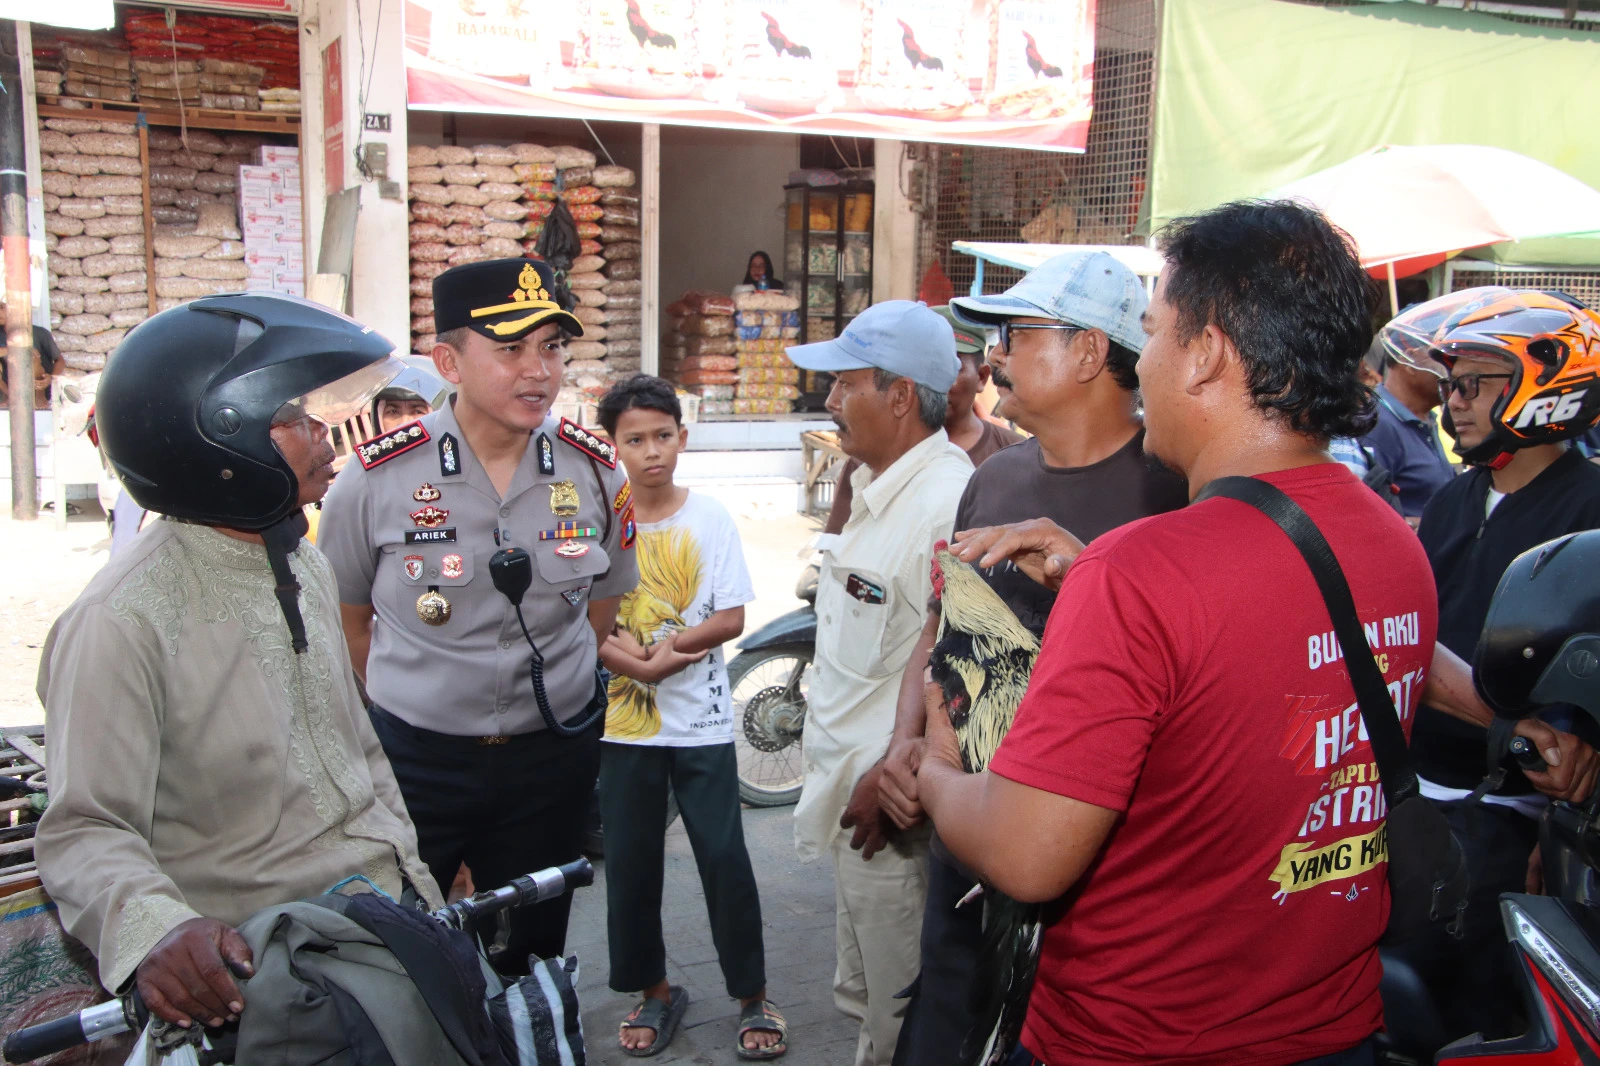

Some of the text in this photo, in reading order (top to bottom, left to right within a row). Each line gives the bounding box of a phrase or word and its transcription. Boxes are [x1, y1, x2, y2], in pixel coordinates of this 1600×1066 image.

[457, 22, 537, 42] RAJAWALI
[366, 115, 388, 129] ZA 1
[1513, 388, 1589, 429] R6
[414, 530, 448, 541] ARIEK
[1307, 611, 1419, 670] BUN AKU
[1329, 763, 1367, 790] TAPI
[1297, 782, 1387, 837] ISTRI
[1290, 843, 1353, 886] YANG
